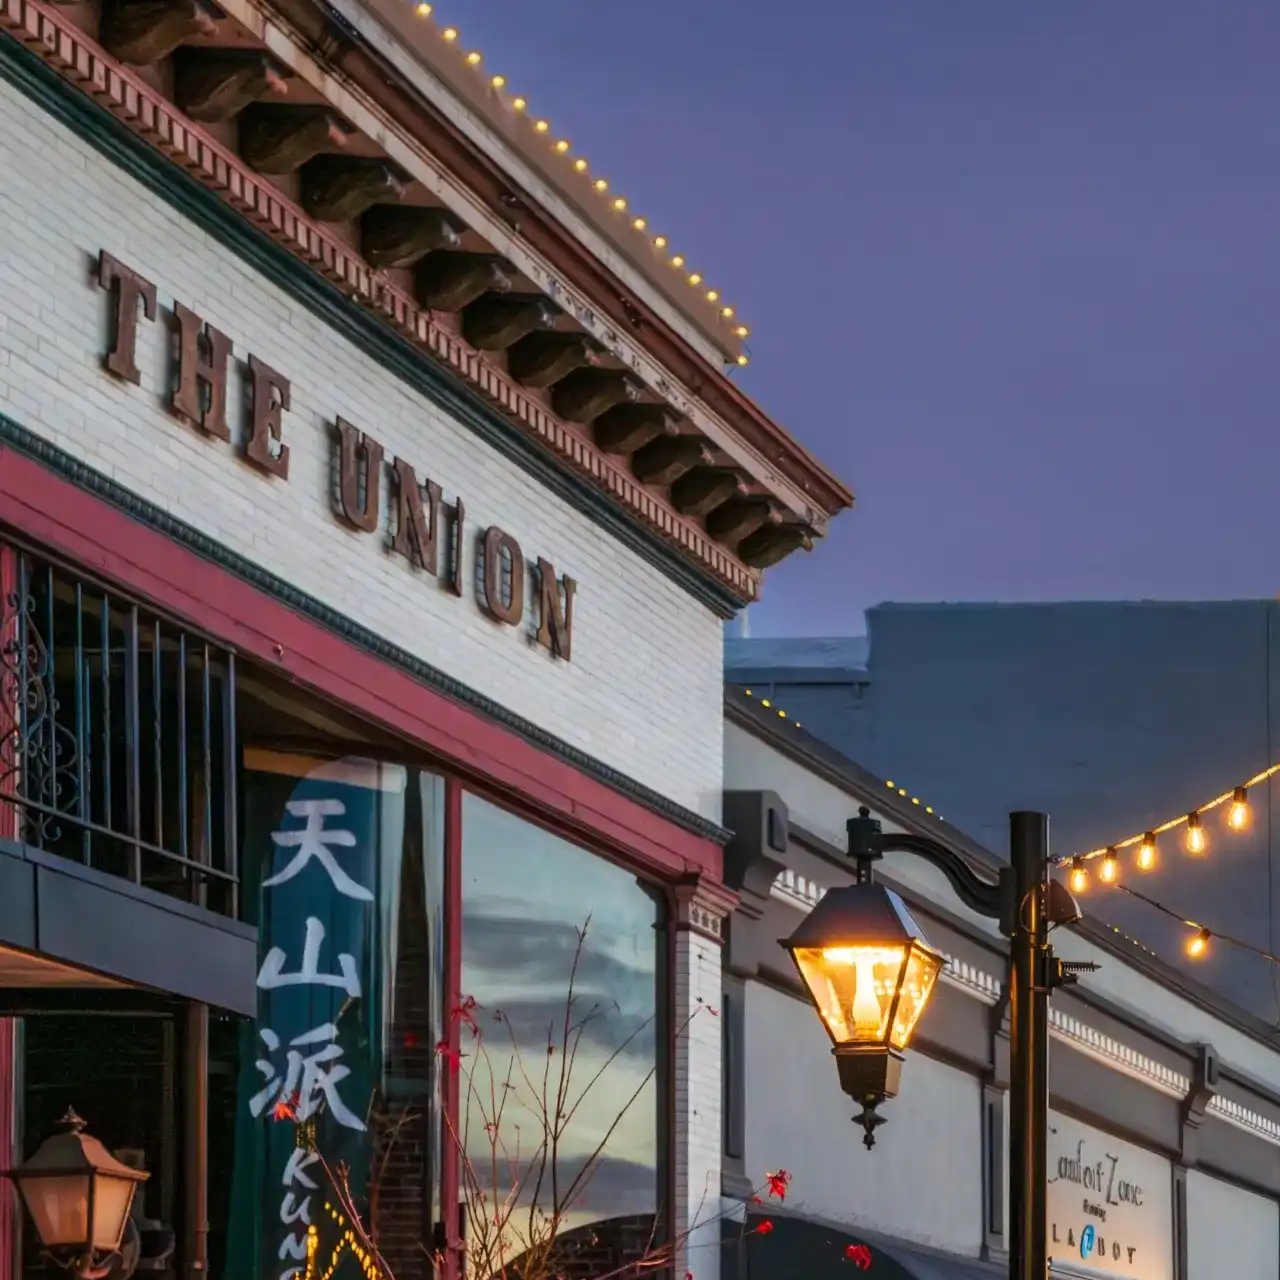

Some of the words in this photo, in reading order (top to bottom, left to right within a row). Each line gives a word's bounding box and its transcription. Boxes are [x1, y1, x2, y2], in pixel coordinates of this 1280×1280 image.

[97, 248, 292, 481] THE
[334, 413, 578, 663] UNION
[248, 798, 376, 1133] 天山派
[1105, 1152, 1144, 1206] Zone
